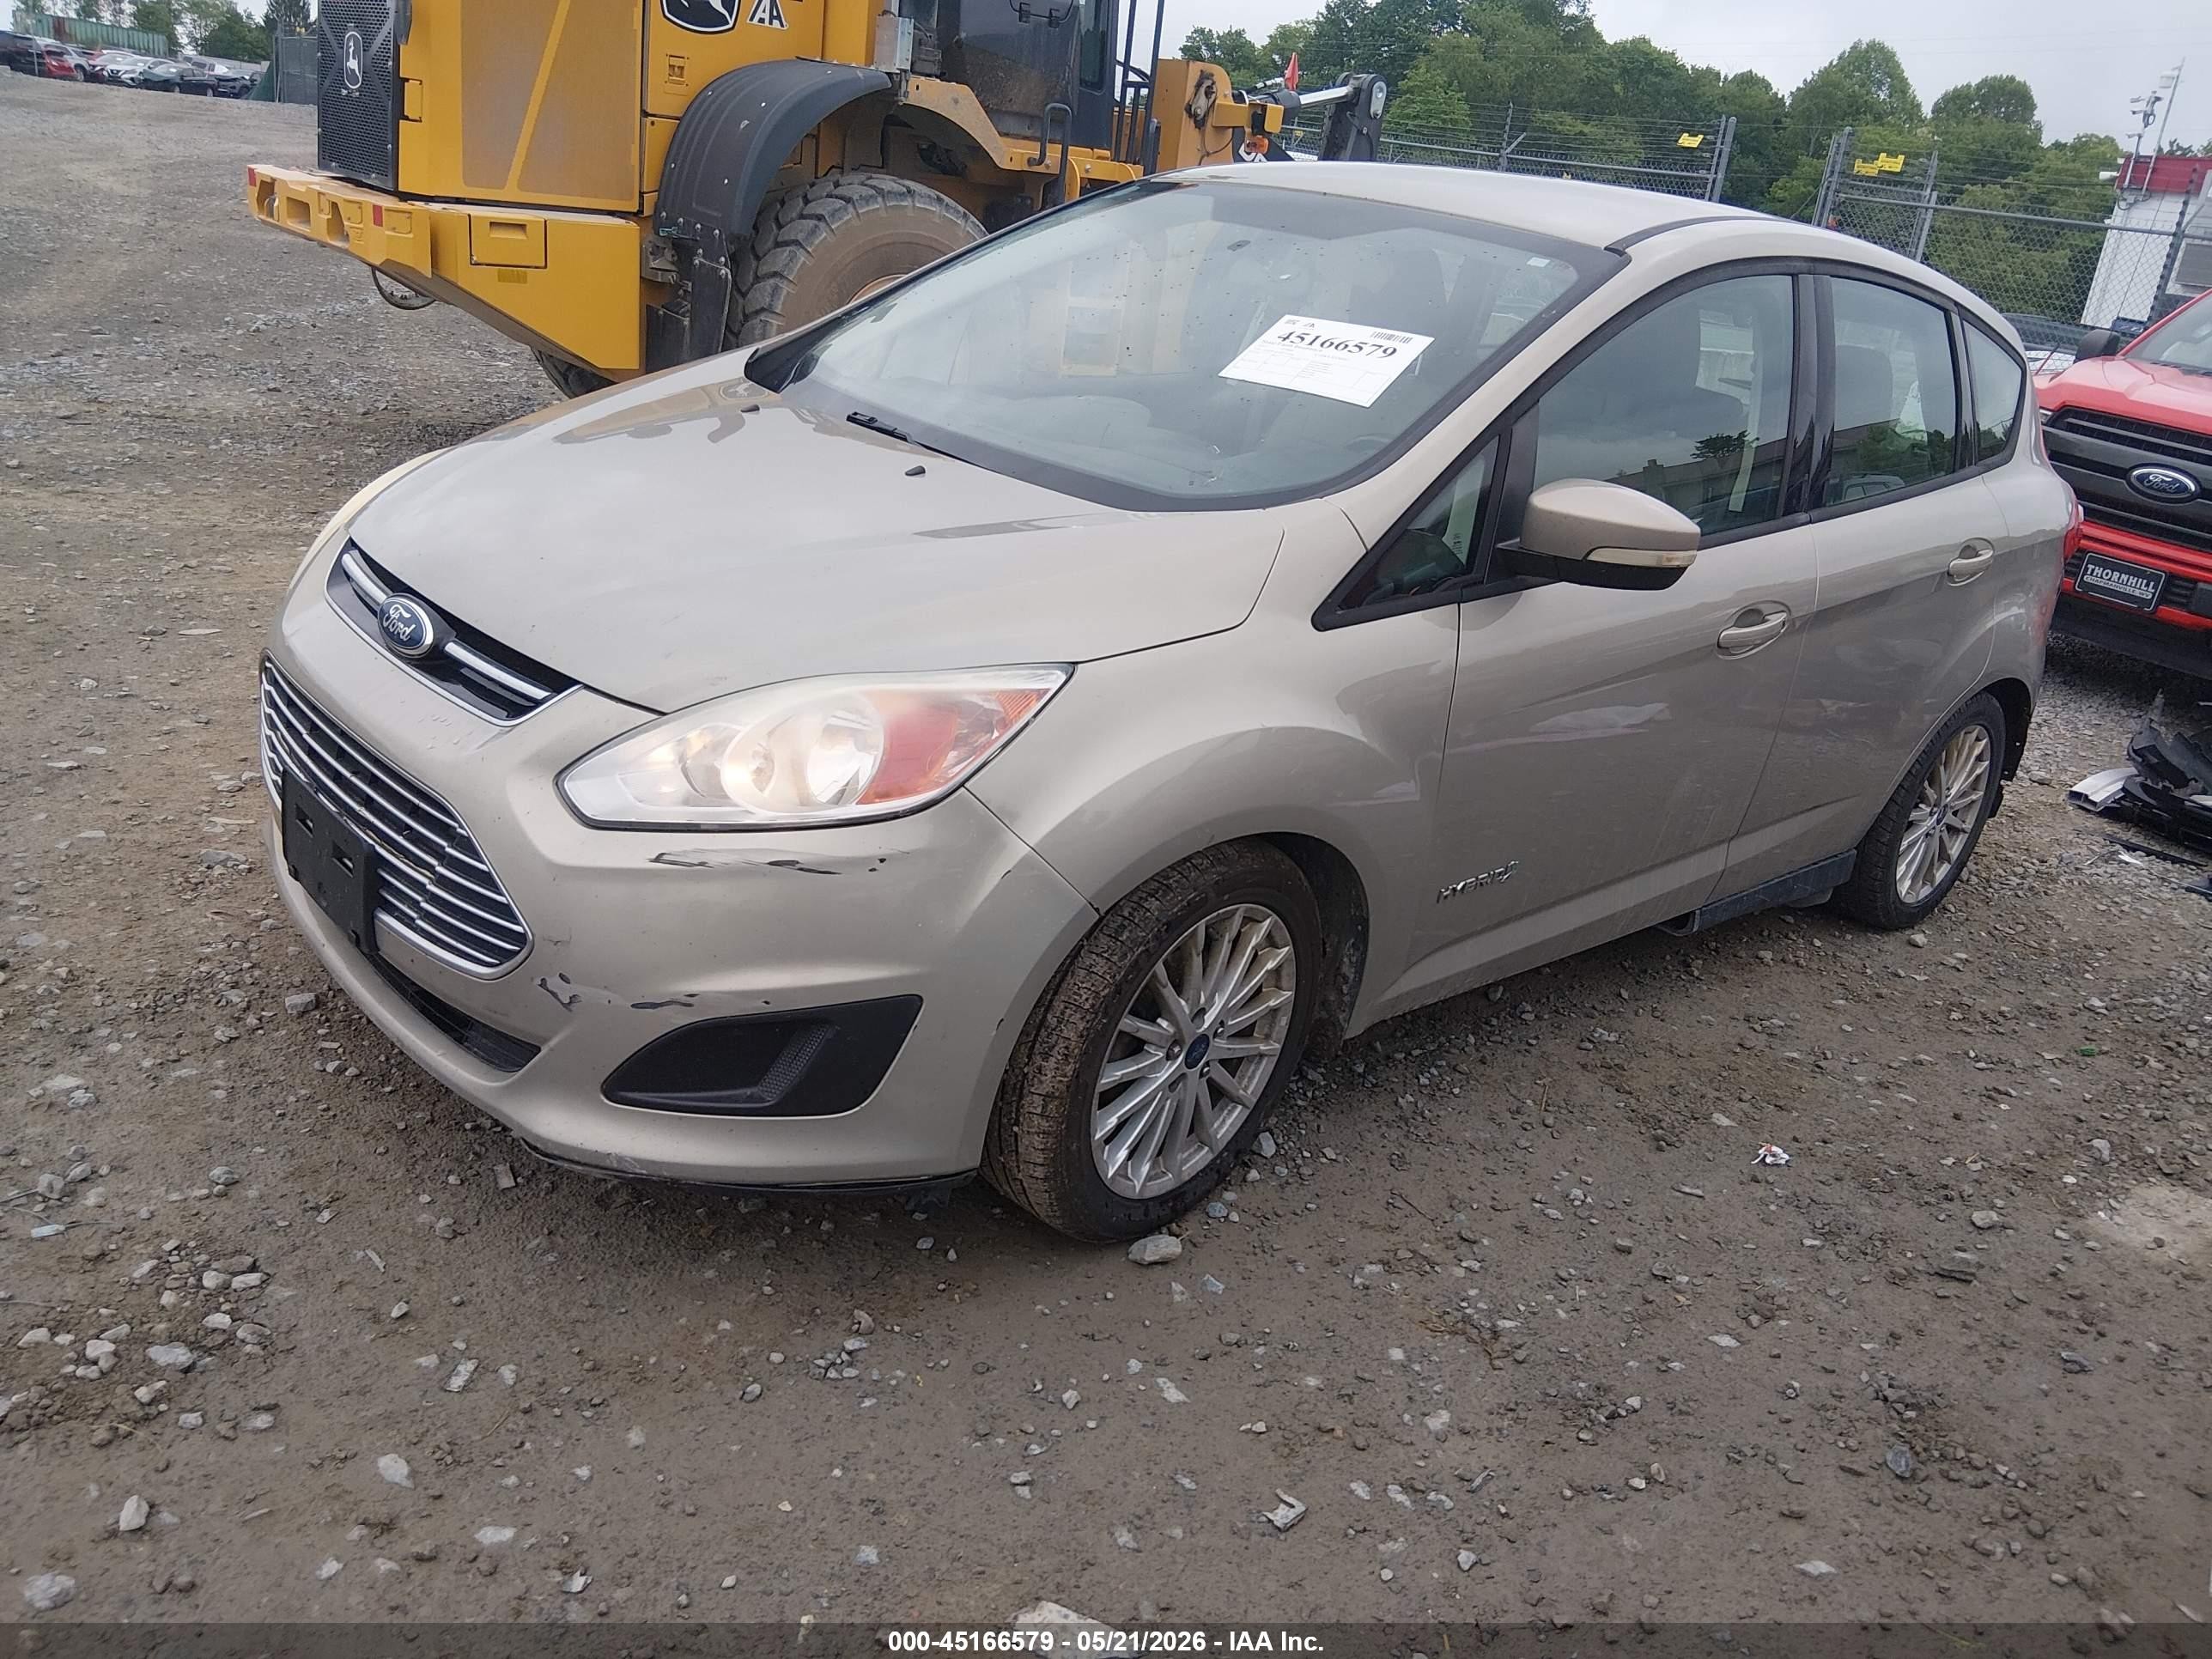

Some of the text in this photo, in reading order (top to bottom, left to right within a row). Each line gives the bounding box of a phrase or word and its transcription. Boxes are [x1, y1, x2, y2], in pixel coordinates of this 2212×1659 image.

[1277, 331, 1397, 359] 45166579
[2144, 473, 2179, 493] Ford
[2087, 564, 2155, 592] THORNHILL
[383, 604, 416, 641] Ford
